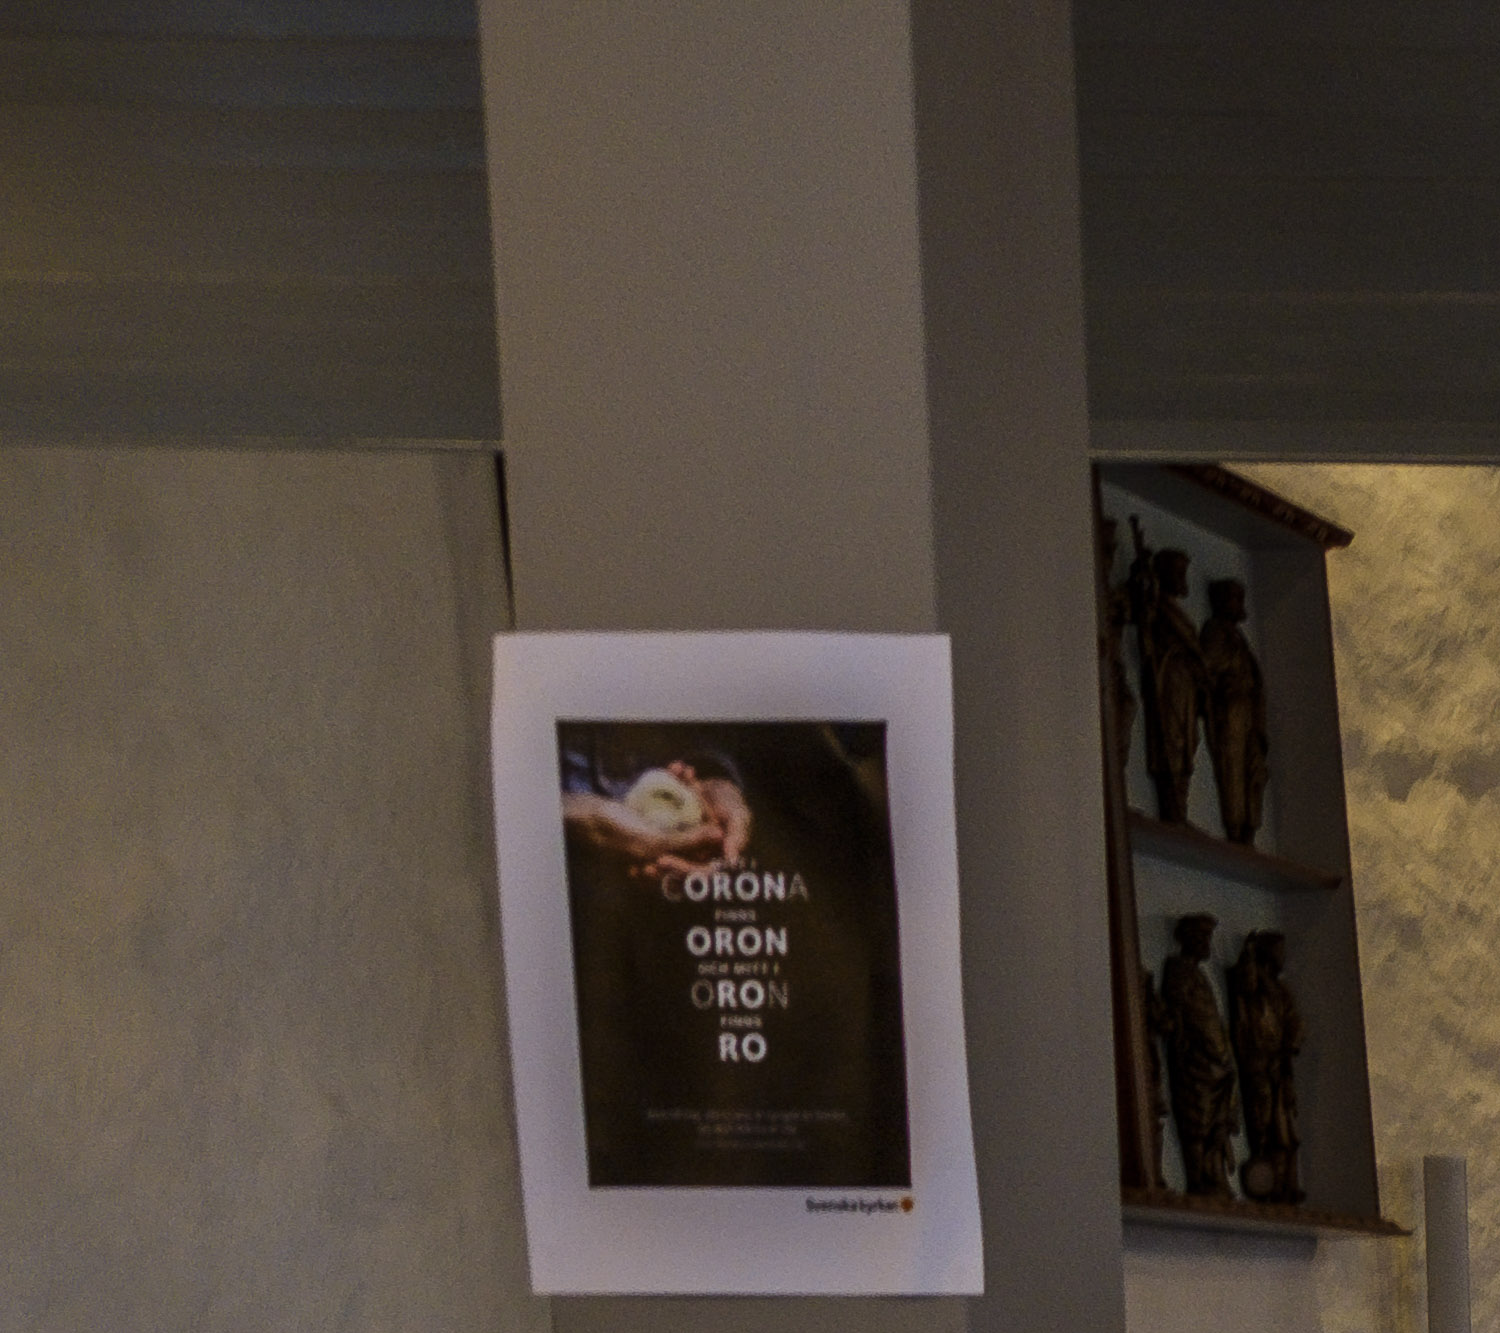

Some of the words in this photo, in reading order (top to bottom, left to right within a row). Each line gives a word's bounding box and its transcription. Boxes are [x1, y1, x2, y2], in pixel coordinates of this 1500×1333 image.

[661, 870, 809, 901] CORONA
[686, 925, 788, 957] ORON
[690, 979, 789, 1010] ORON
[718, 1031, 768, 1063] RO
